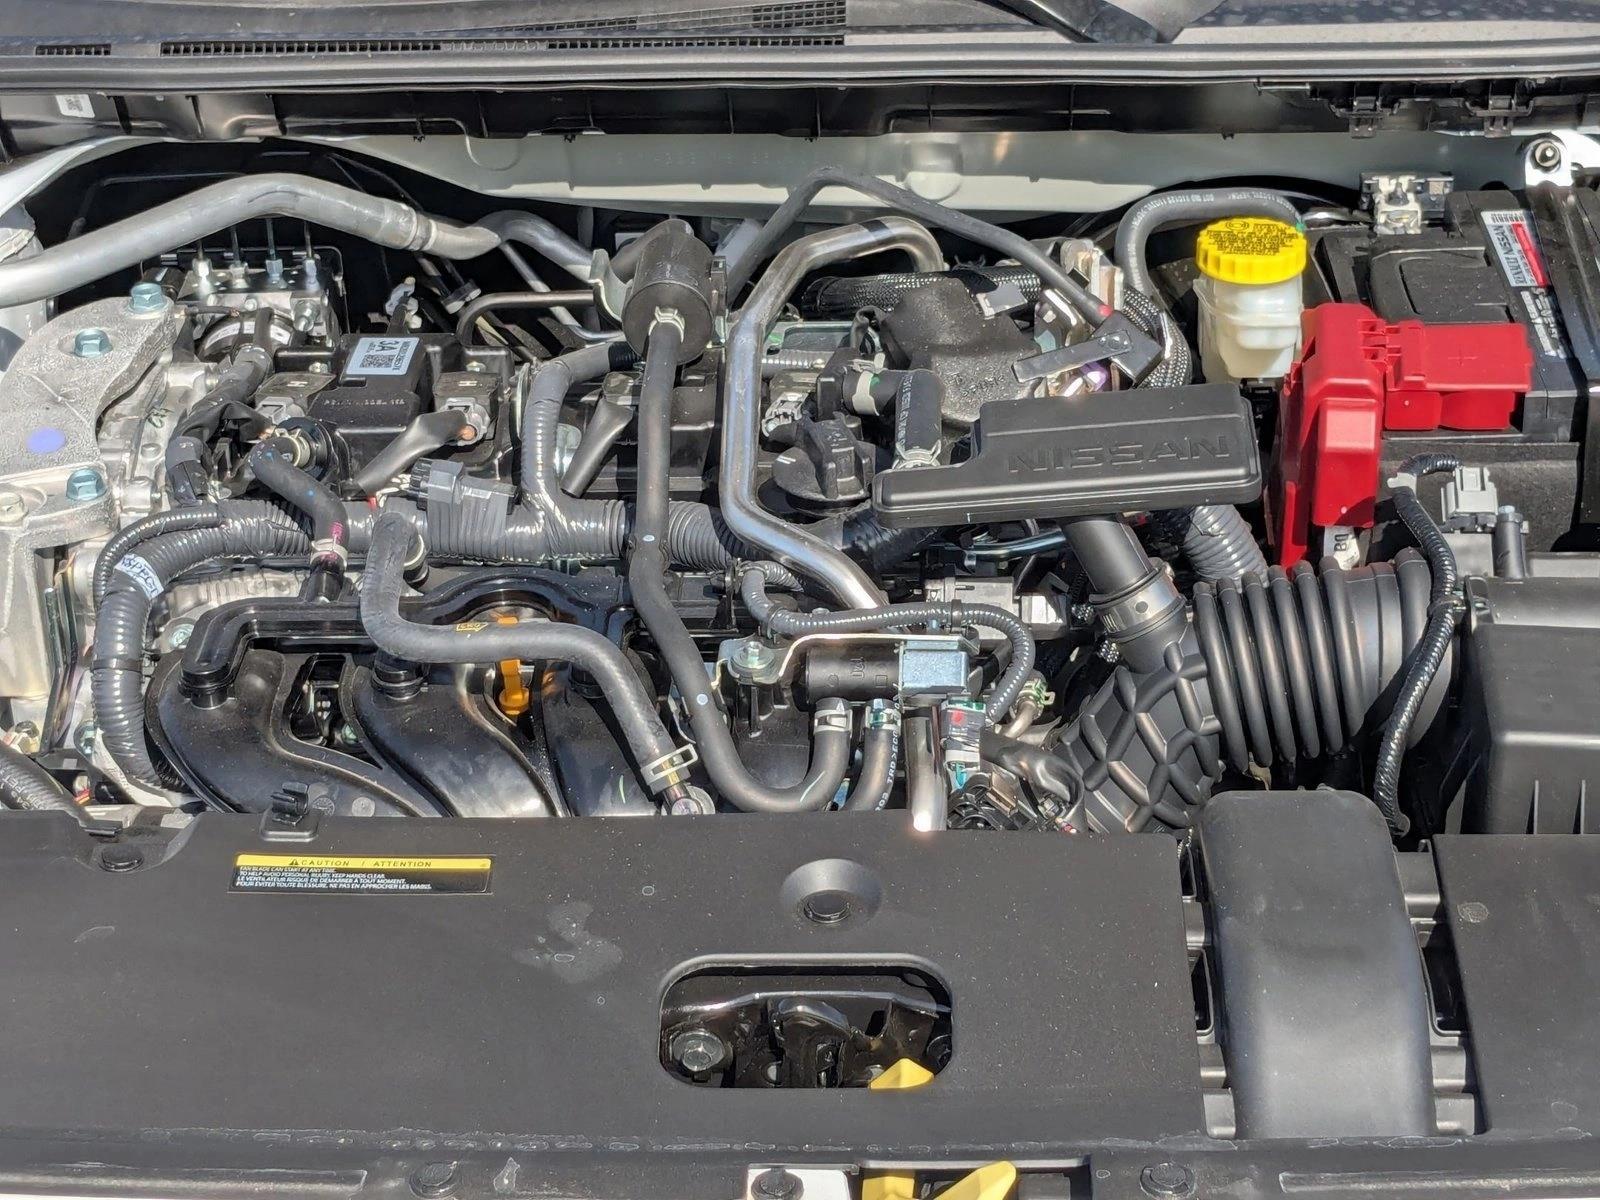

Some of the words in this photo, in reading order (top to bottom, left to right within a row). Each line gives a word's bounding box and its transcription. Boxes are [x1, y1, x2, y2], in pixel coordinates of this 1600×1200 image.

[1007, 434, 1232, 474] NISSAN
[301, 859, 350, 867] CAUTION
[373, 860, 432, 868] ATTENTION
